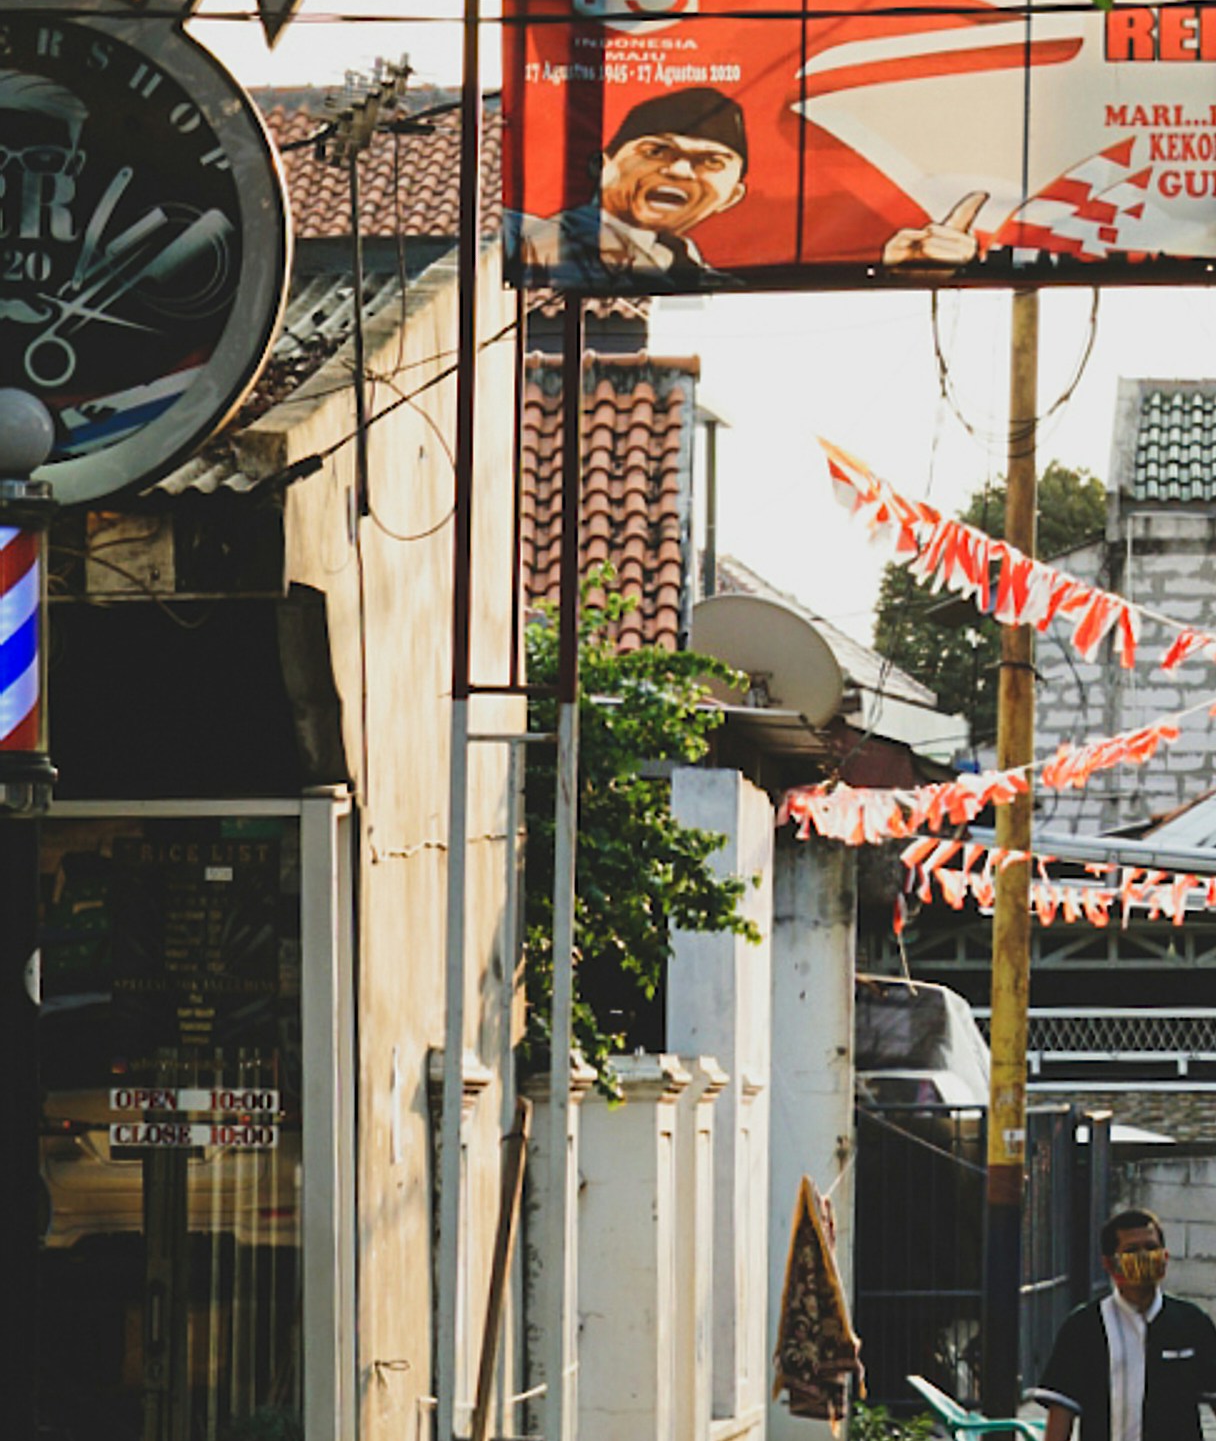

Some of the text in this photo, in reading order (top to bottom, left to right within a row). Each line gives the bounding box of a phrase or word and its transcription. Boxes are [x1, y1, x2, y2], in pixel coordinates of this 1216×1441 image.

[574, 38, 698, 50] INDONESIA
[605, 51, 666, 62] MAJU
[525, 64, 539, 82] 17
[543, 61, 596, 85] Agustus
[636, 64, 652, 83] 17
[655, 62, 707, 87] Agustus
[709, 63, 741, 83] 2020
[0, 173, 80, 242] R
[211, 842, 269, 863] LIST
[115, 1090, 274, 1111] OPEN 10:00
[114, 1124, 274, 1145] CLOSE 10:00
